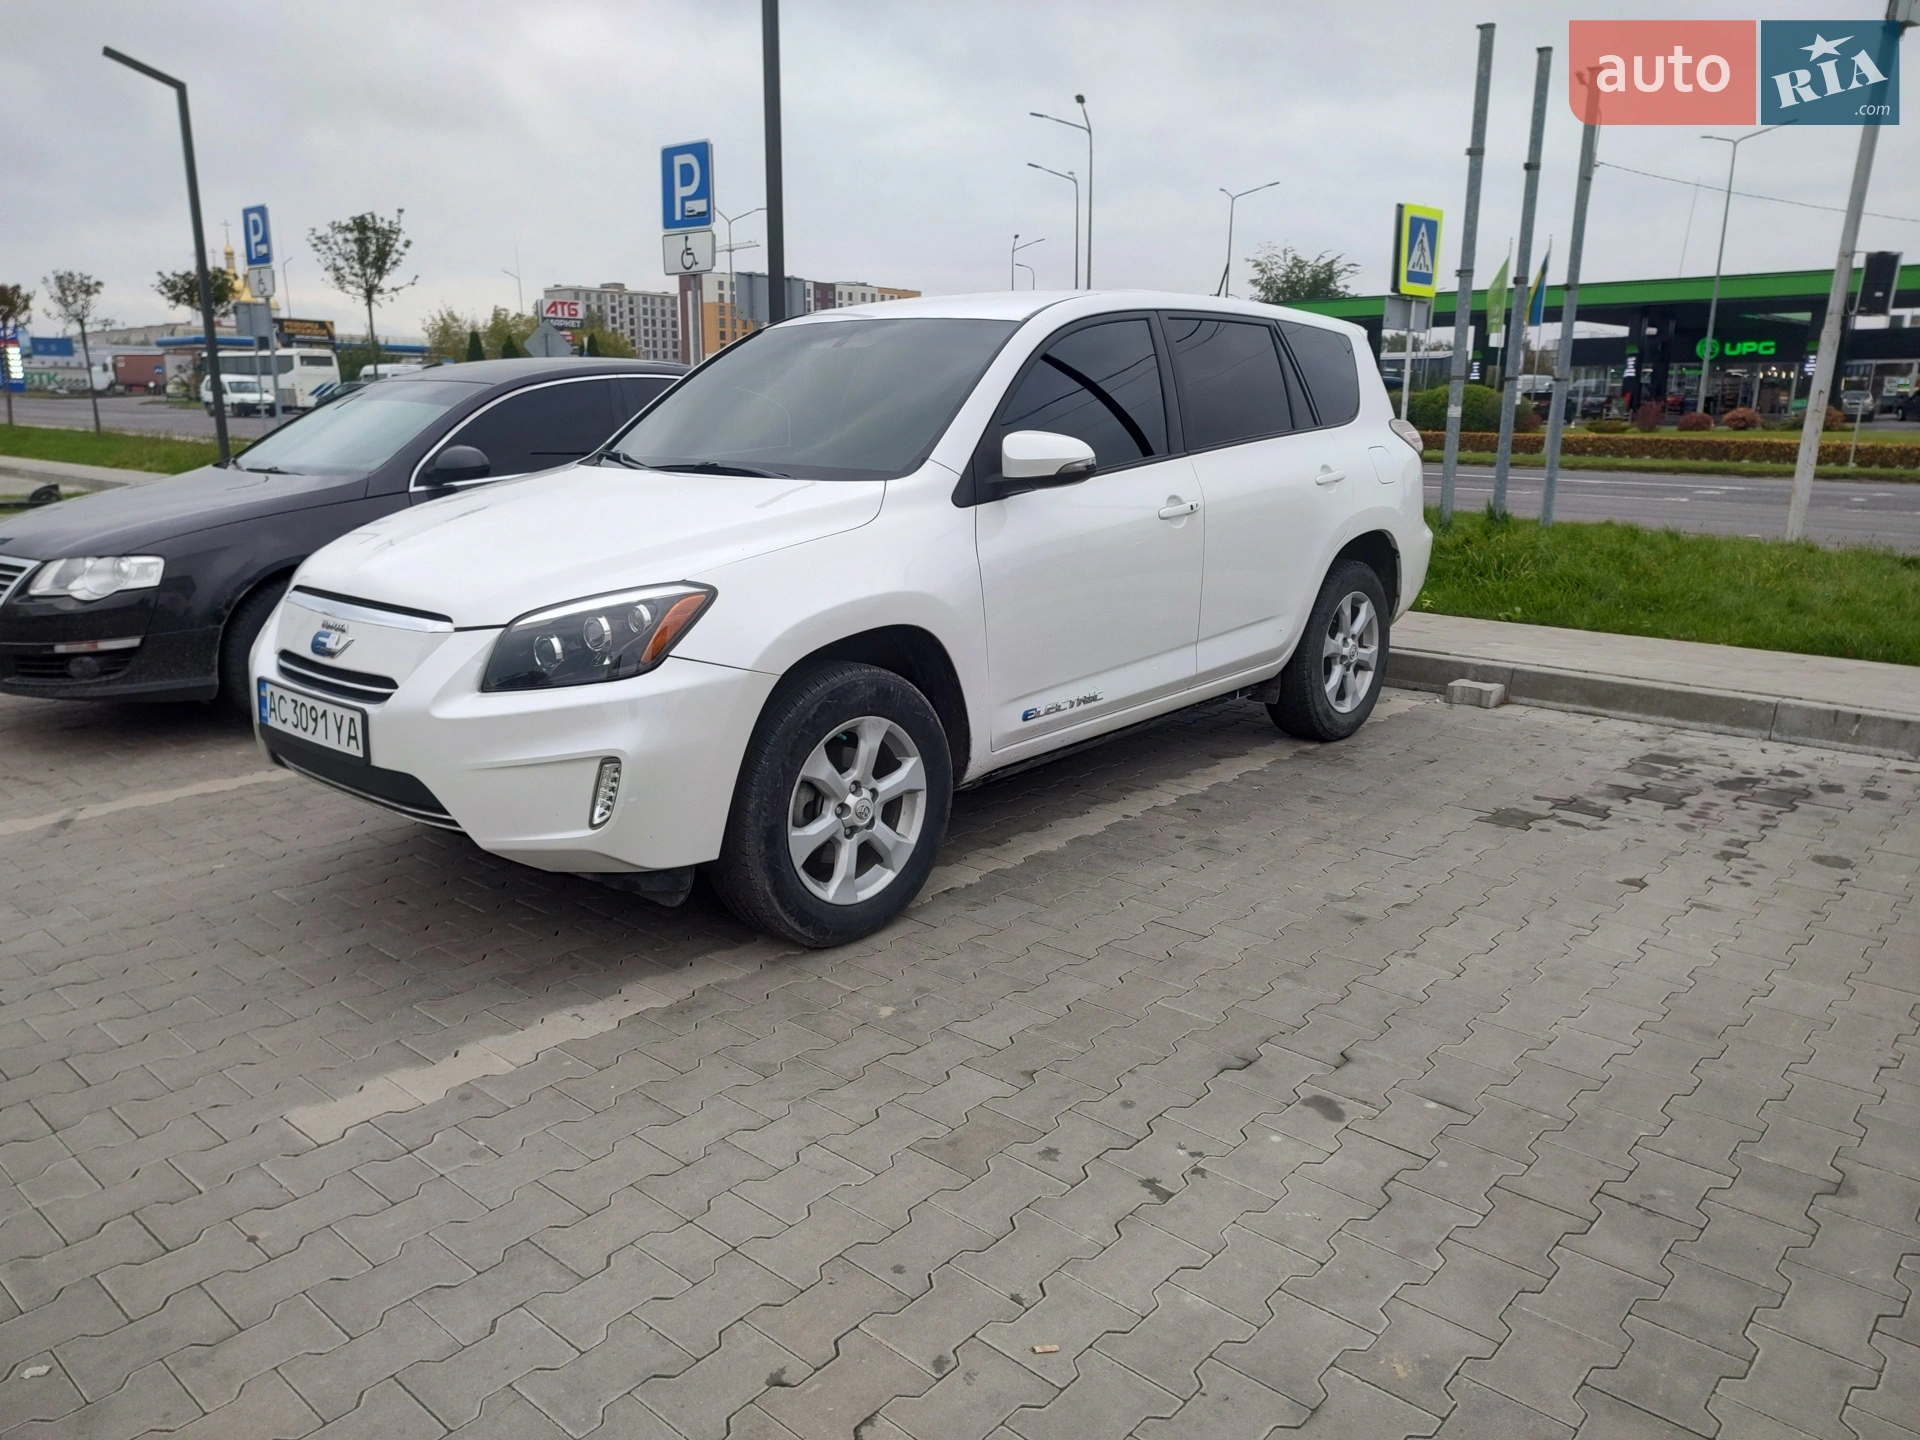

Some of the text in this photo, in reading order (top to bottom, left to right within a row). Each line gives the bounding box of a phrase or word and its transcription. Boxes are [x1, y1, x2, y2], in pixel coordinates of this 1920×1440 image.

[673, 153, 701, 221] P
[248, 212, 264, 260] P
[545, 300, 580, 318] АТБ
[1724, 341, 1776, 356] UPG
